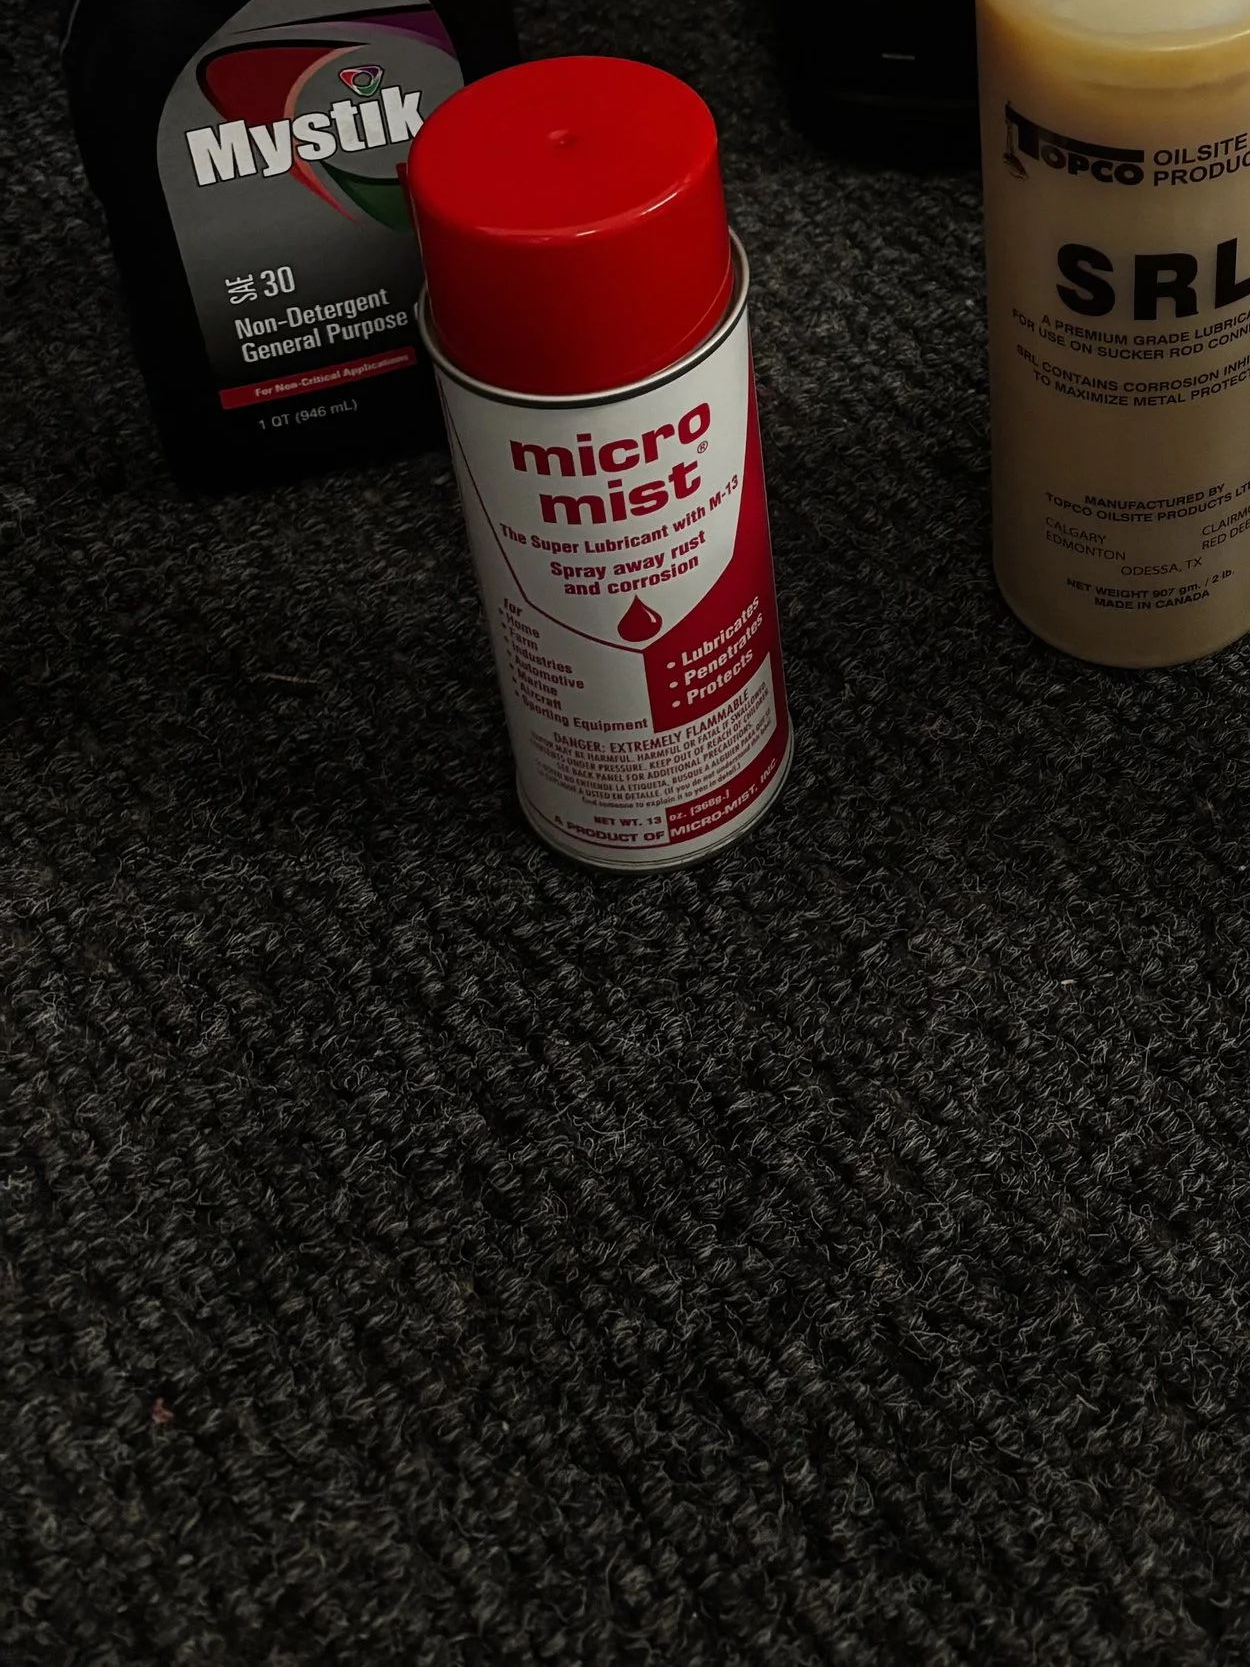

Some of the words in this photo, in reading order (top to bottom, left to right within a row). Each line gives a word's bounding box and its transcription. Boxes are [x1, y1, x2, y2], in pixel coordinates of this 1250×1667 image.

[184, 84, 425, 188] Mystik
[1153, 132, 1249, 166] OILSITE
[224, 273, 258, 306] SAE
[260, 265, 296, 298] 30
[234, 288, 391, 340] Non-Detergent
[1041, 315, 1051, 327] A
[1055, 320, 1128, 346] PREMIUM
[1133, 331, 1190, 346] GRADE
[241, 327, 322, 364] General
[326, 310, 409, 345] Purpose
[1012, 307, 1035, 333] FOR
[1038, 327, 1066, 347] USE
[1070, 340, 1093, 354] ON
[1097, 346, 1164, 360] SUCKER
[1169, 343, 1204, 359] ROD
[254, 386, 274, 398] For
[275, 371, 341, 393] Non-Critical
[1033, 369, 1051, 386] TO
[1055, 381, 1129, 406] MAXIMIZE
[1133, 393, 1186, 407] METAL
[1042, 361, 1119, 392] CONTAINS
[1123, 369, 1220, 394] CORROSION
[258, 419, 267, 431] 1
[271, 414, 290, 428] QT
[295, 405, 327, 424] (946
[330, 398, 358, 416] mL)
[509, 402, 711, 477] micro
[539, 460, 702, 526] mist
[1046, 491, 1093, 518] TOPCO
[1096, 509, 1154, 522] OILSITE
[1157, 494, 1233, 522] PRODUCTS
[1084, 490, 1205, 511] MANUFACTURED
[1208, 483, 1226, 499] BY
[499, 522, 527, 545] The
[531, 535, 579, 555] Super
[584, 524, 669, 554] Lubricant
[673, 506, 706, 533] with
[708, 473, 739, 512] M-13
[1045, 516, 1107, 546] CALGARY
[1045, 530, 1127, 562] EDMONTON
[1201, 532, 1227, 551] RED
[549, 560, 606, 581] Spray
[613, 552, 665, 577] away
[670, 530, 707, 560] rust
[1120, 563, 1182, 577] ODESSA,
[1185, 556, 1203, 569] TX
[563, 581, 601, 596] and
[607, 554, 700, 595] corrosion
[1067, 577, 1091, 593] NET
[1095, 586, 1149, 599] WEIGHT
[1153, 587, 1175, 598] 907
[1211, 573, 1219, 584] 2
[503, 597, 523, 617] for
[1094, 597, 1134, 609] MADE
[1137, 600, 1151, 610] IN
[1155, 589, 1211, 609] CANADA
[506, 612, 541, 639] Home
[509, 626, 539, 652] Farm
[680, 596, 760, 667] Lubricates
[511, 641, 573, 675] Industries
[683, 612, 764, 687] Penetrates
[514, 655, 585, 690] Automotive
[517, 668, 559, 697] Marine
[685, 648, 754, 706] Protects
[519, 682, 563, 711] Aircraft
[521, 693, 570, 727] Sporting
[572, 717, 649, 733] Equipment
[553, 731, 606, 753] DANGER:
[610, 731, 682, 754] EXTREMELY
[686, 687, 749, 739] FLAMMABLE
[566, 821, 639, 842] PRODUCT
[643, 829, 665, 842] OF
[593, 815, 616, 826] NET
[619, 818, 642, 827] WT.
[647, 816, 661, 825] 13
